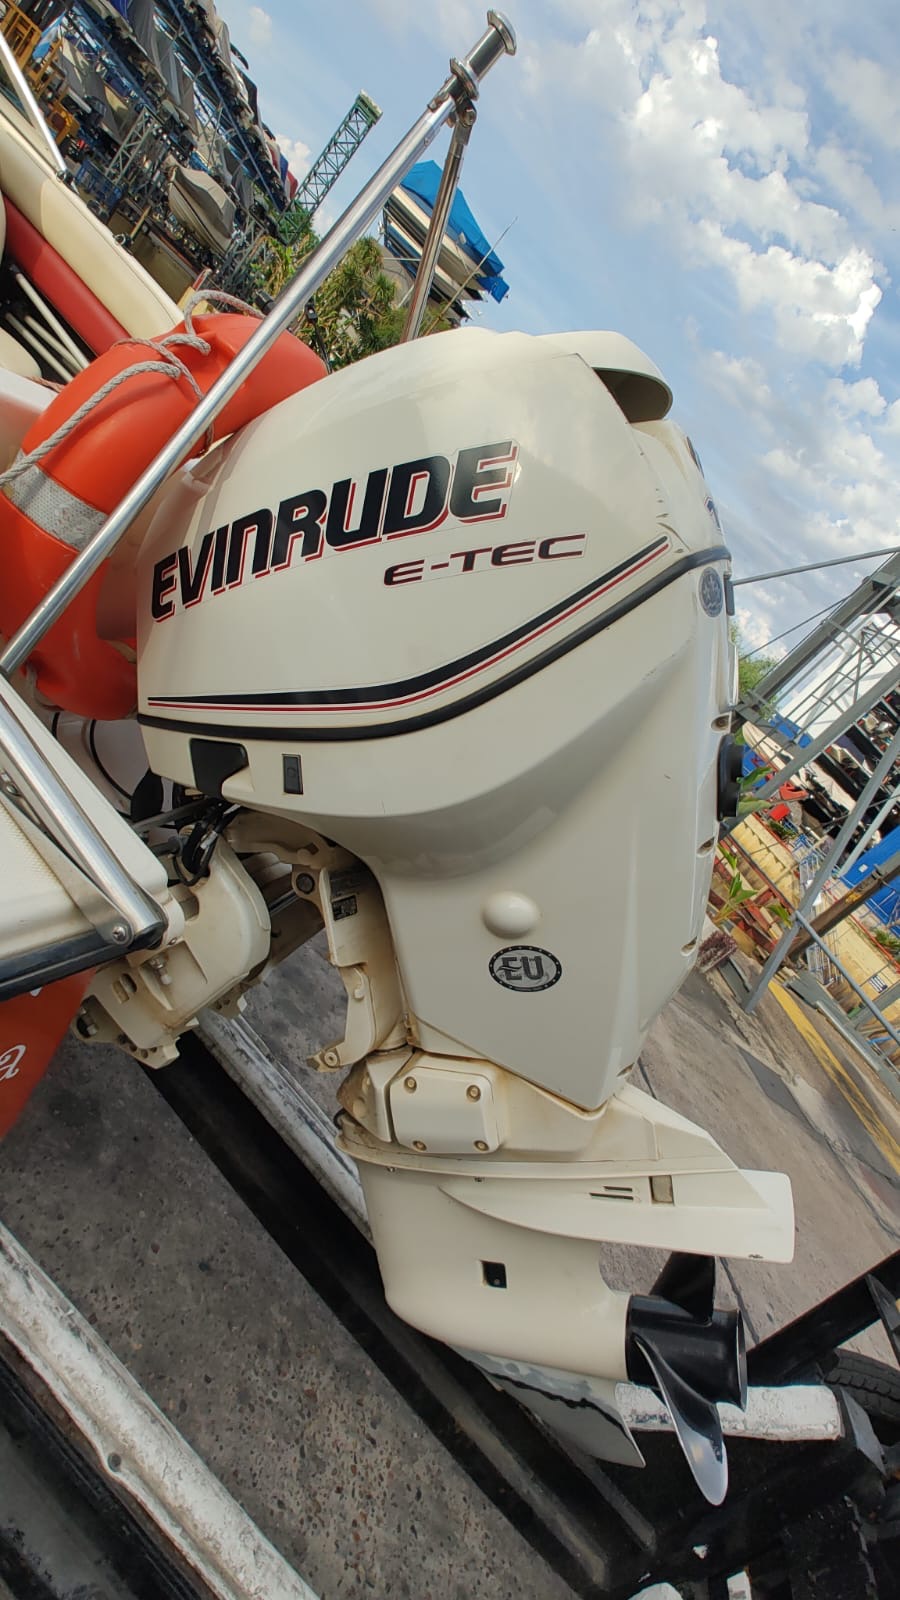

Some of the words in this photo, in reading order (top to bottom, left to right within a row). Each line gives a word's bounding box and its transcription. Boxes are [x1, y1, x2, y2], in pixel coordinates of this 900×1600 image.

[151, 440, 517, 623] EVINRUDE
[384, 533, 587, 586] E-TEC
[500, 956, 544, 981] EU
